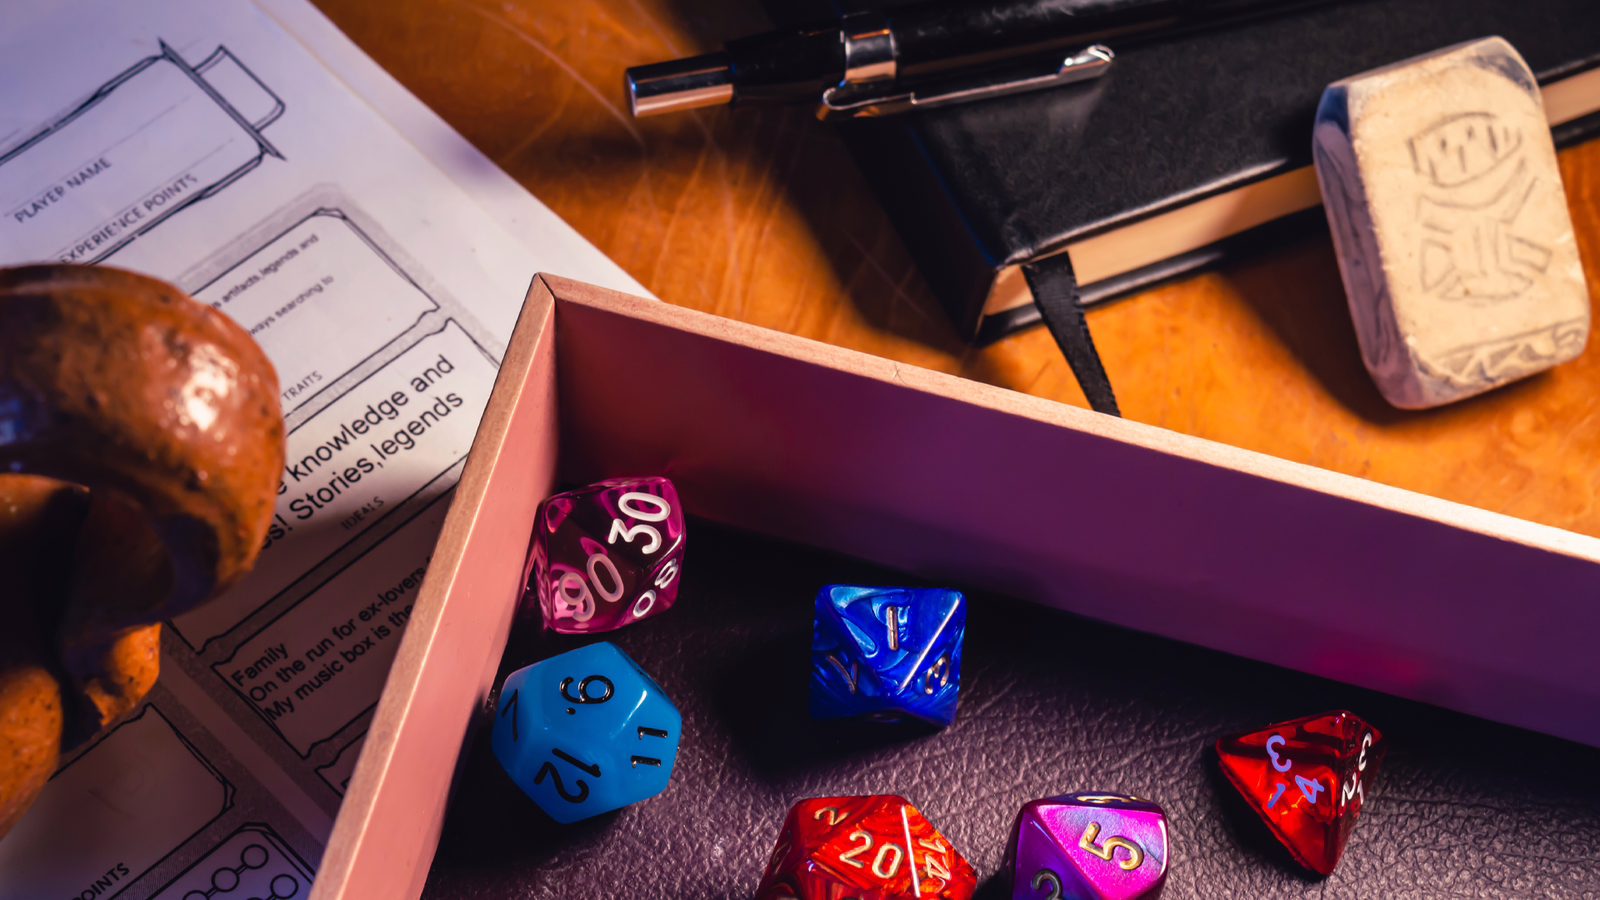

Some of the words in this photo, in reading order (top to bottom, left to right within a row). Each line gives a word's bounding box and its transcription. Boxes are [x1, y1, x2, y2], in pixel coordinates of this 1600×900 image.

[14, 184, 65, 223] PLAYER
[67, 158, 112, 191] NAME
[59, 206, 145, 264] EXPERIENCE
[144, 173, 198, 213] POINTS
[300, 233, 319, 250] and
[248, 316, 276, 336] ways
[275, 284, 323, 317] searching
[321, 276, 334, 285] to
[282, 370, 323, 401] TRAITS
[285, 390, 410, 482] knowledge
[411, 354, 455, 393] and
[342, 496, 385, 531] IDEALS
[607, 491, 672, 555] 30
[558, 552, 625, 623] 90
[249, 682, 279, 702] On
[276, 660, 305, 683] the
[306, 639, 334, 662] run
[333, 619, 358, 641] for
[358, 566, 426, 622] ex-lovers
[231, 643, 289, 687] Family
[265, 696, 295, 721] My
[295, 659, 344, 700] music
[340, 637, 375, 663] box
[371, 625, 391, 641] is
[630, 725, 668, 769] 11
[1266, 734, 1292, 773] 3
[1358, 732, 1373, 772] 3
[533, 747, 602, 804] 12
[1294, 774, 1325, 804] 4
[839, 830, 904, 880] 20
[918, 837, 952, 882] 14
[1078, 821, 1145, 871] 5
